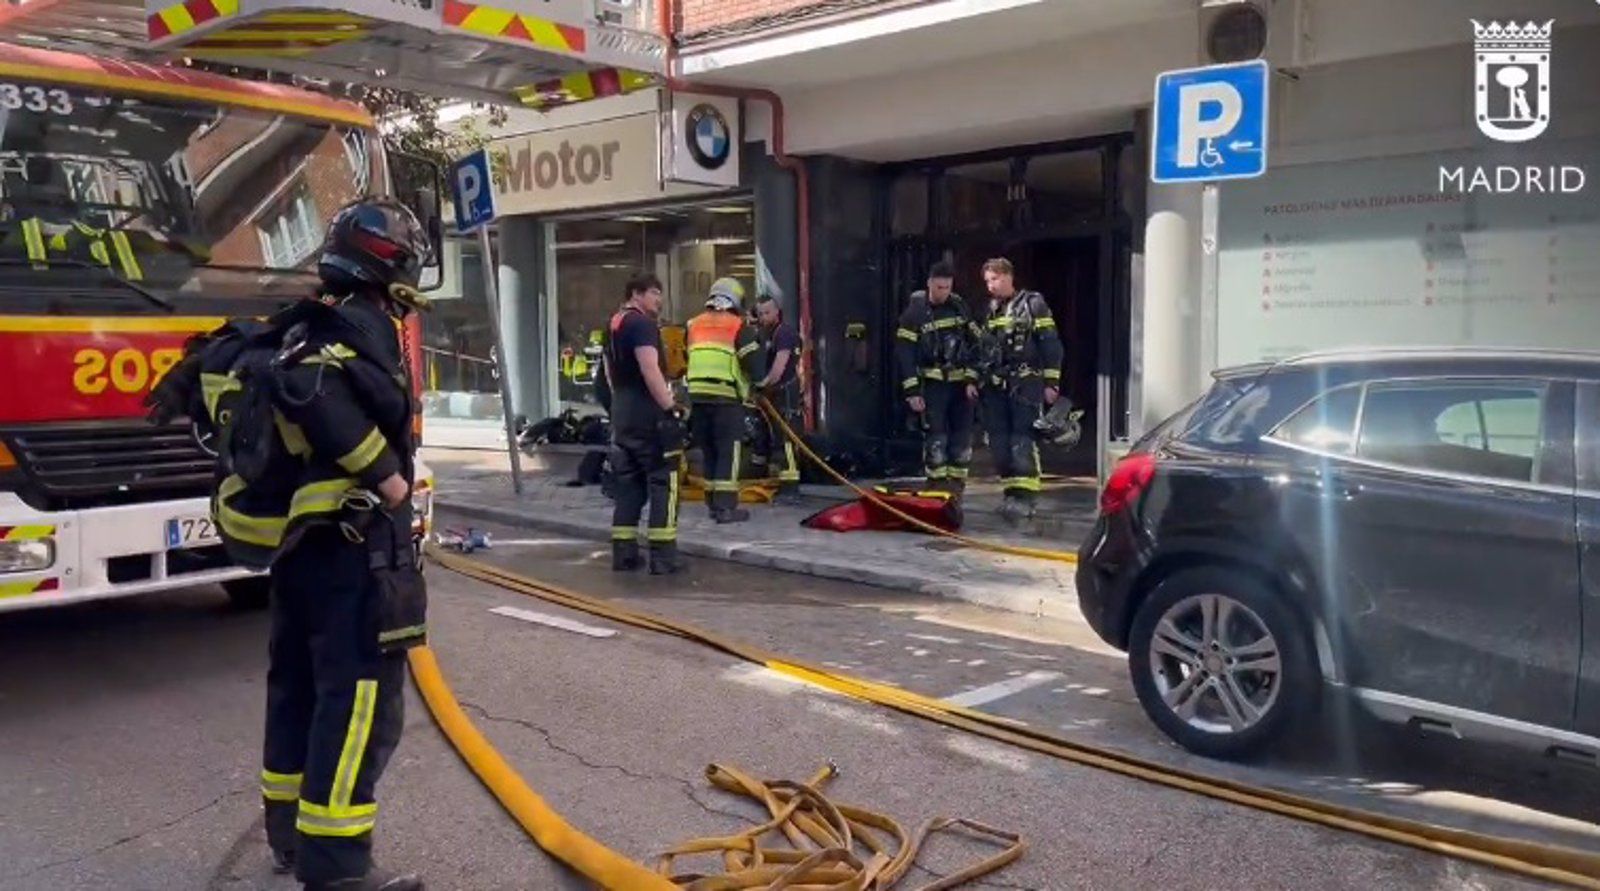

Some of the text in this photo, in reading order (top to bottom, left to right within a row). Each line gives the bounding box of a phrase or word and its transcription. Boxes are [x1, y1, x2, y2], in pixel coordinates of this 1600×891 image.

[1177, 81, 1242, 167] P
[457, 164, 480, 223] P
[500, 139, 620, 194] Motor
[182, 518, 219, 541] 72
